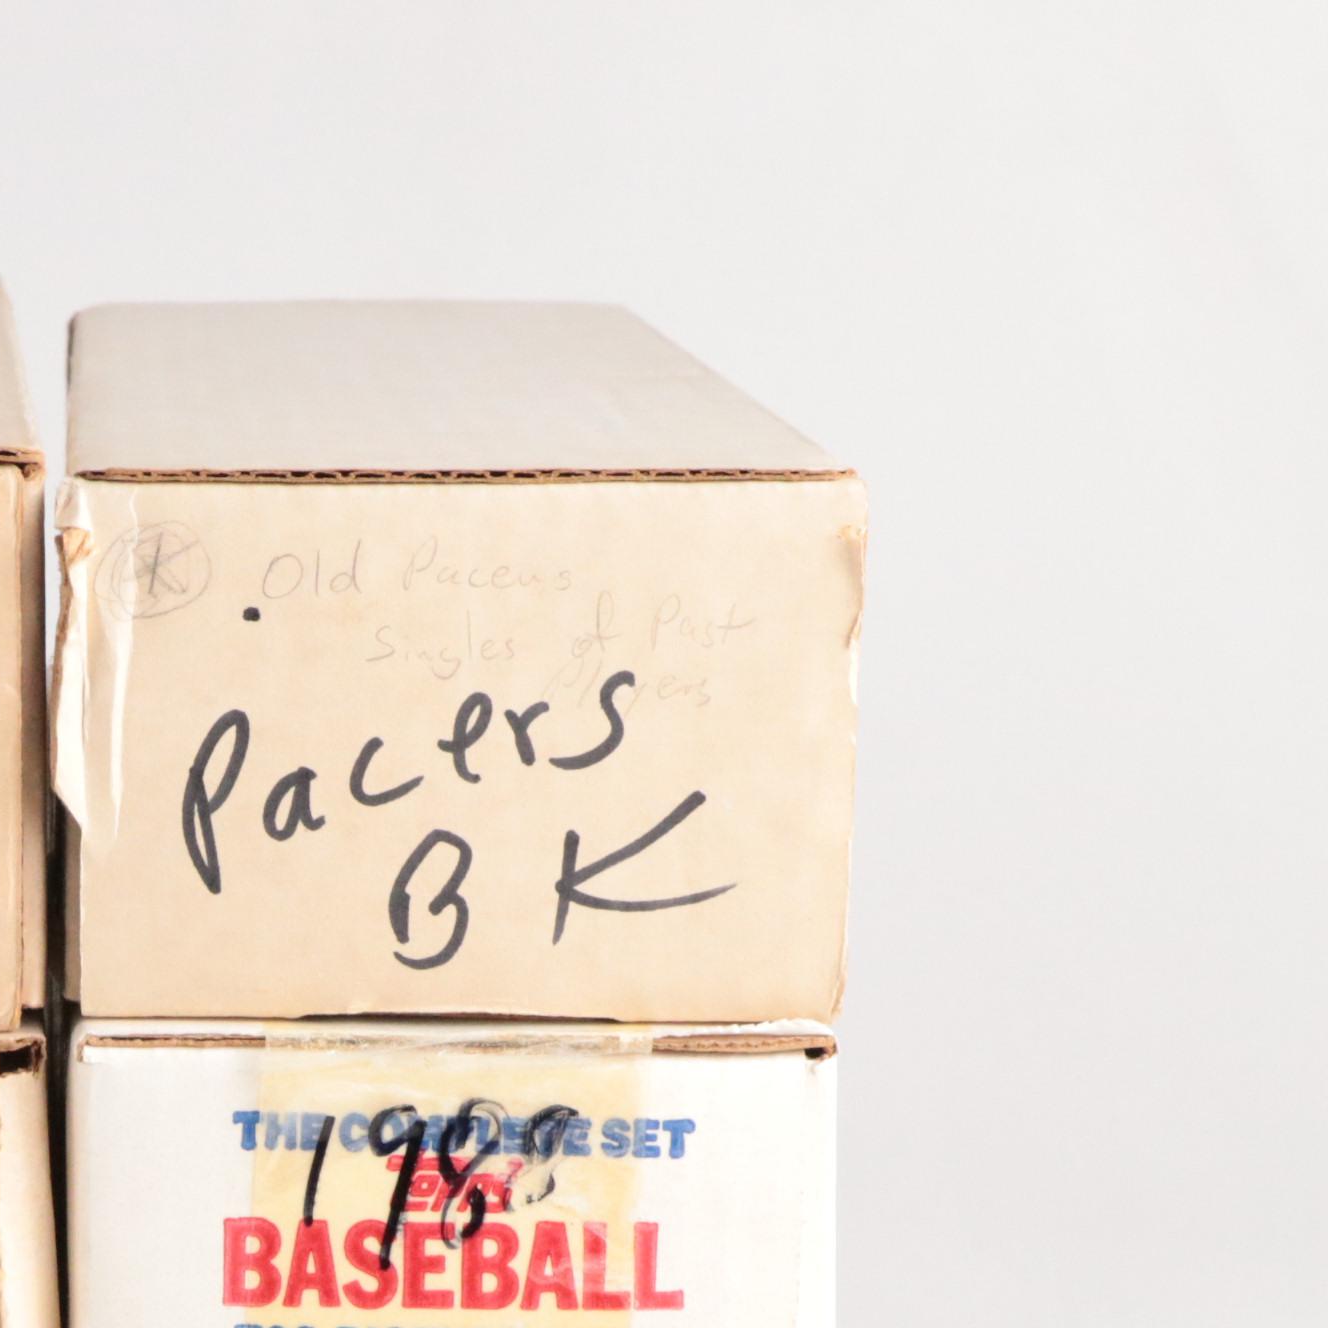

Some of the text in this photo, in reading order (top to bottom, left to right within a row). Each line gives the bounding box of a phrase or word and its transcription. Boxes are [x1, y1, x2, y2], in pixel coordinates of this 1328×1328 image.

[261, 538, 363, 600] Old
[364, 590, 759, 681] Singles of Past
[181, 670, 636, 895] Pacers
[231, 1109, 325, 1152] THE
[599, 1117, 697, 1160] SET
[221, 1215, 686, 1312] BASEBALL
